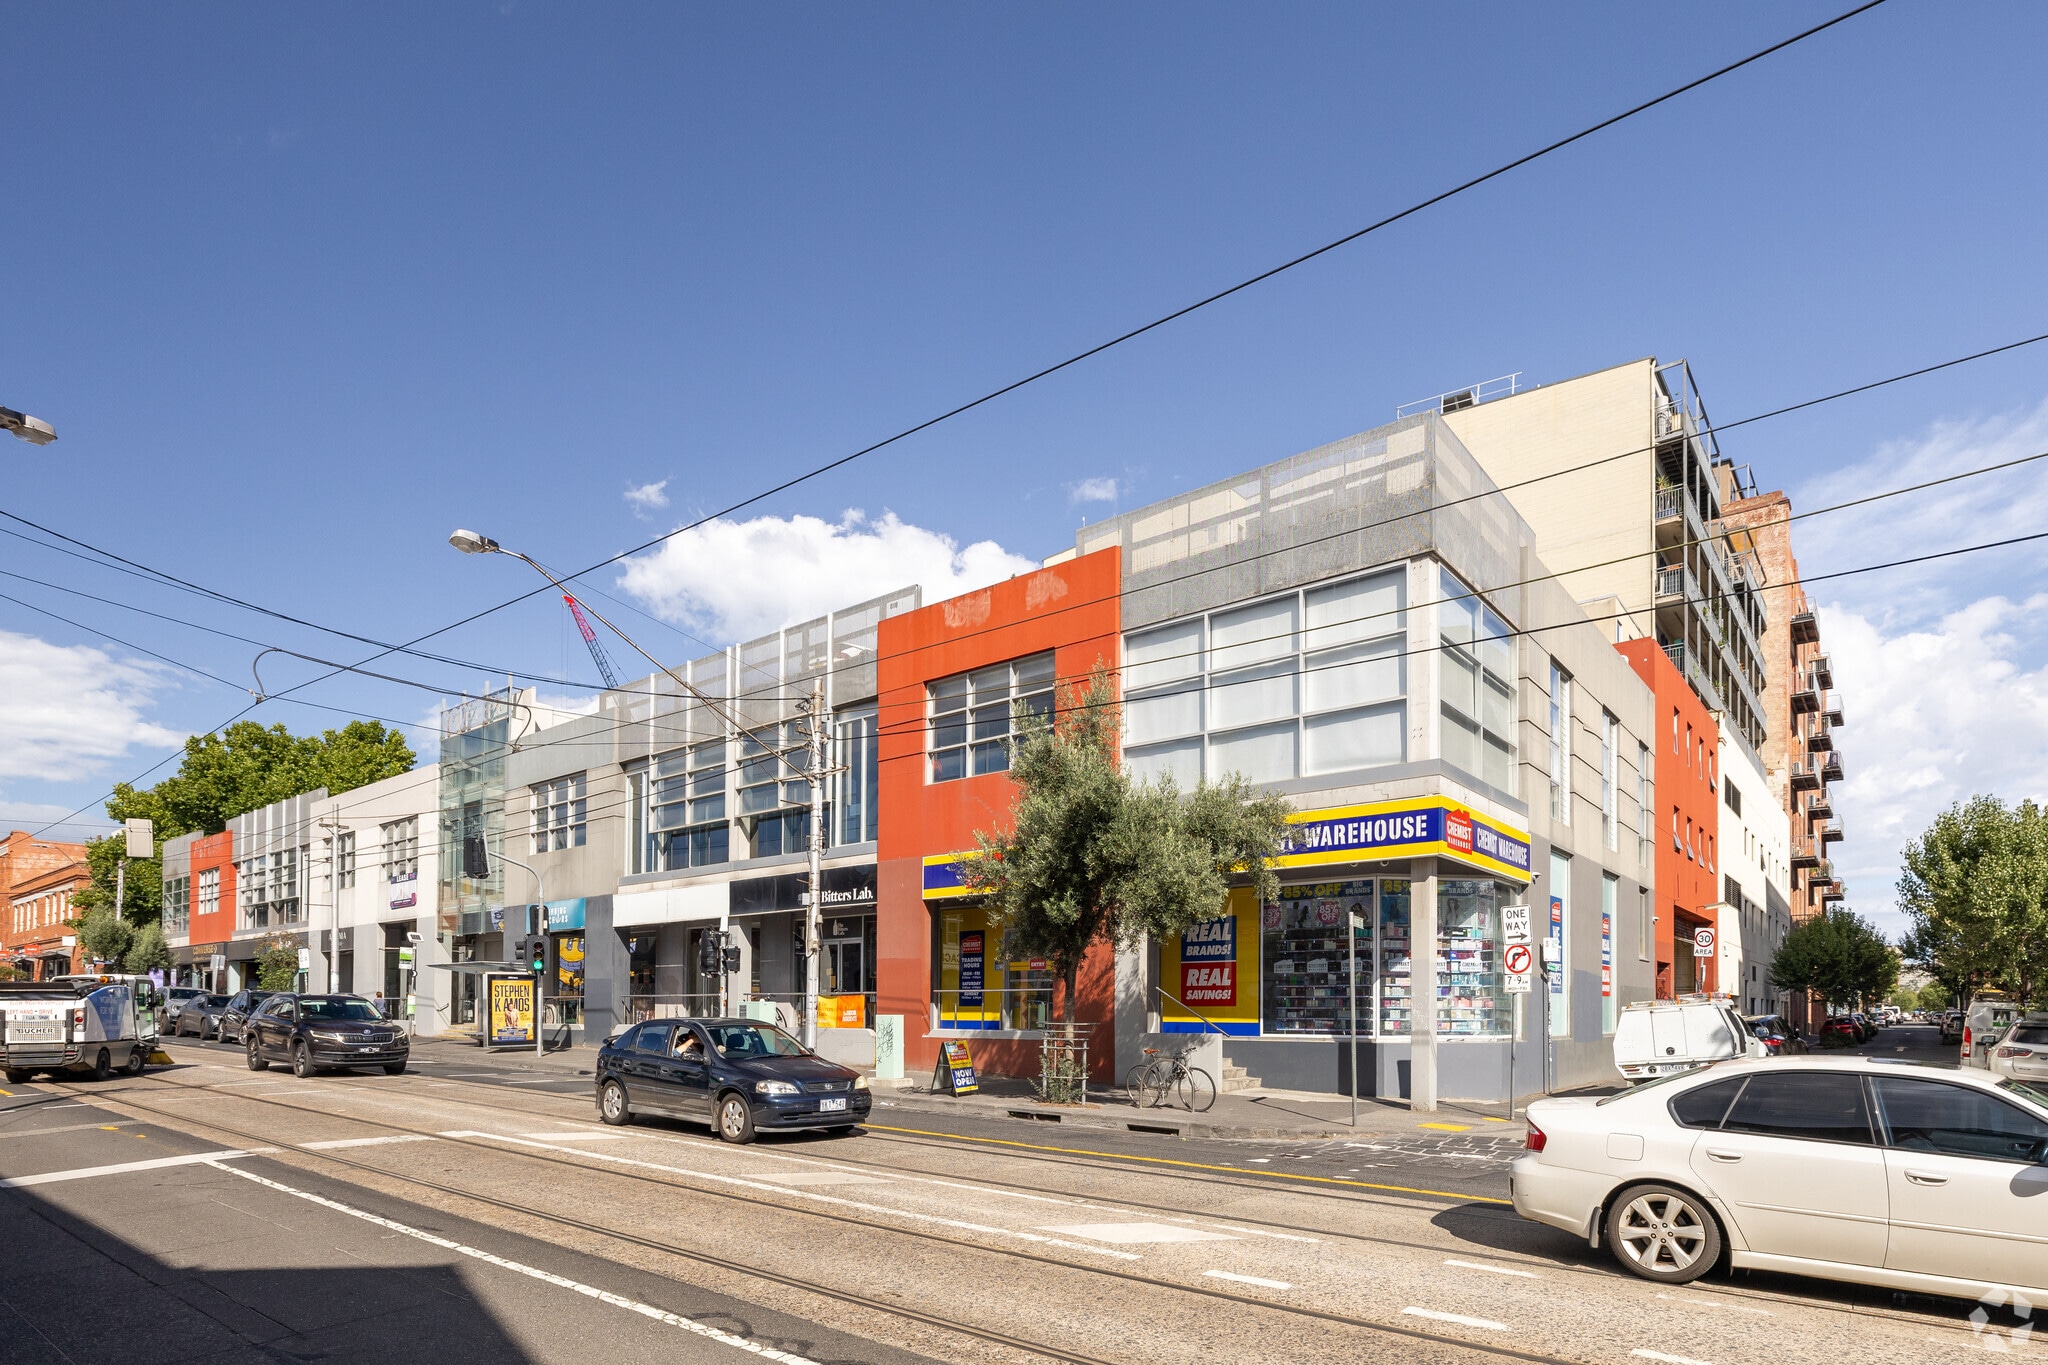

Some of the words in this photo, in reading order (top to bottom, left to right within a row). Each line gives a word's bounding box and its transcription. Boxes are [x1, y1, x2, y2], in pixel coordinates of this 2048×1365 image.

[1304, 814, 1428, 848] WAREHOUSE
[1447, 820, 1472, 841] CHEMIST
[1477, 827, 1498, 855] CHEMIST
[1498, 837, 1527, 866] WAREHOUSE
[396, 874, 409, 882] LEASE
[821, 890, 852, 902] Bitters
[852, 886, 874, 900] Lab.
[1283, 886, 1312, 898] 85%
[1314, 883, 1342, 896] OFF
[1320, 905, 1338, 914] 85%
[1506, 909, 1526, 919] ONE
[1506, 920, 1528, 930] WAY
[1186, 922, 1232, 942] REAL
[1698, 934, 1710, 943] 30
[1186, 944, 1232, 956] BRANDS!
[1186, 968, 1232, 986] REAL
[494, 984, 529, 997] STEPHEN
[1186, 990, 1232, 1000] SAVINGS!
[495, 998, 501, 1012] K
[504, 998, 529, 1012] AMOS
[954, 1068, 972, 1078] NOW
[956, 1076, 975, 1086] OPEN
